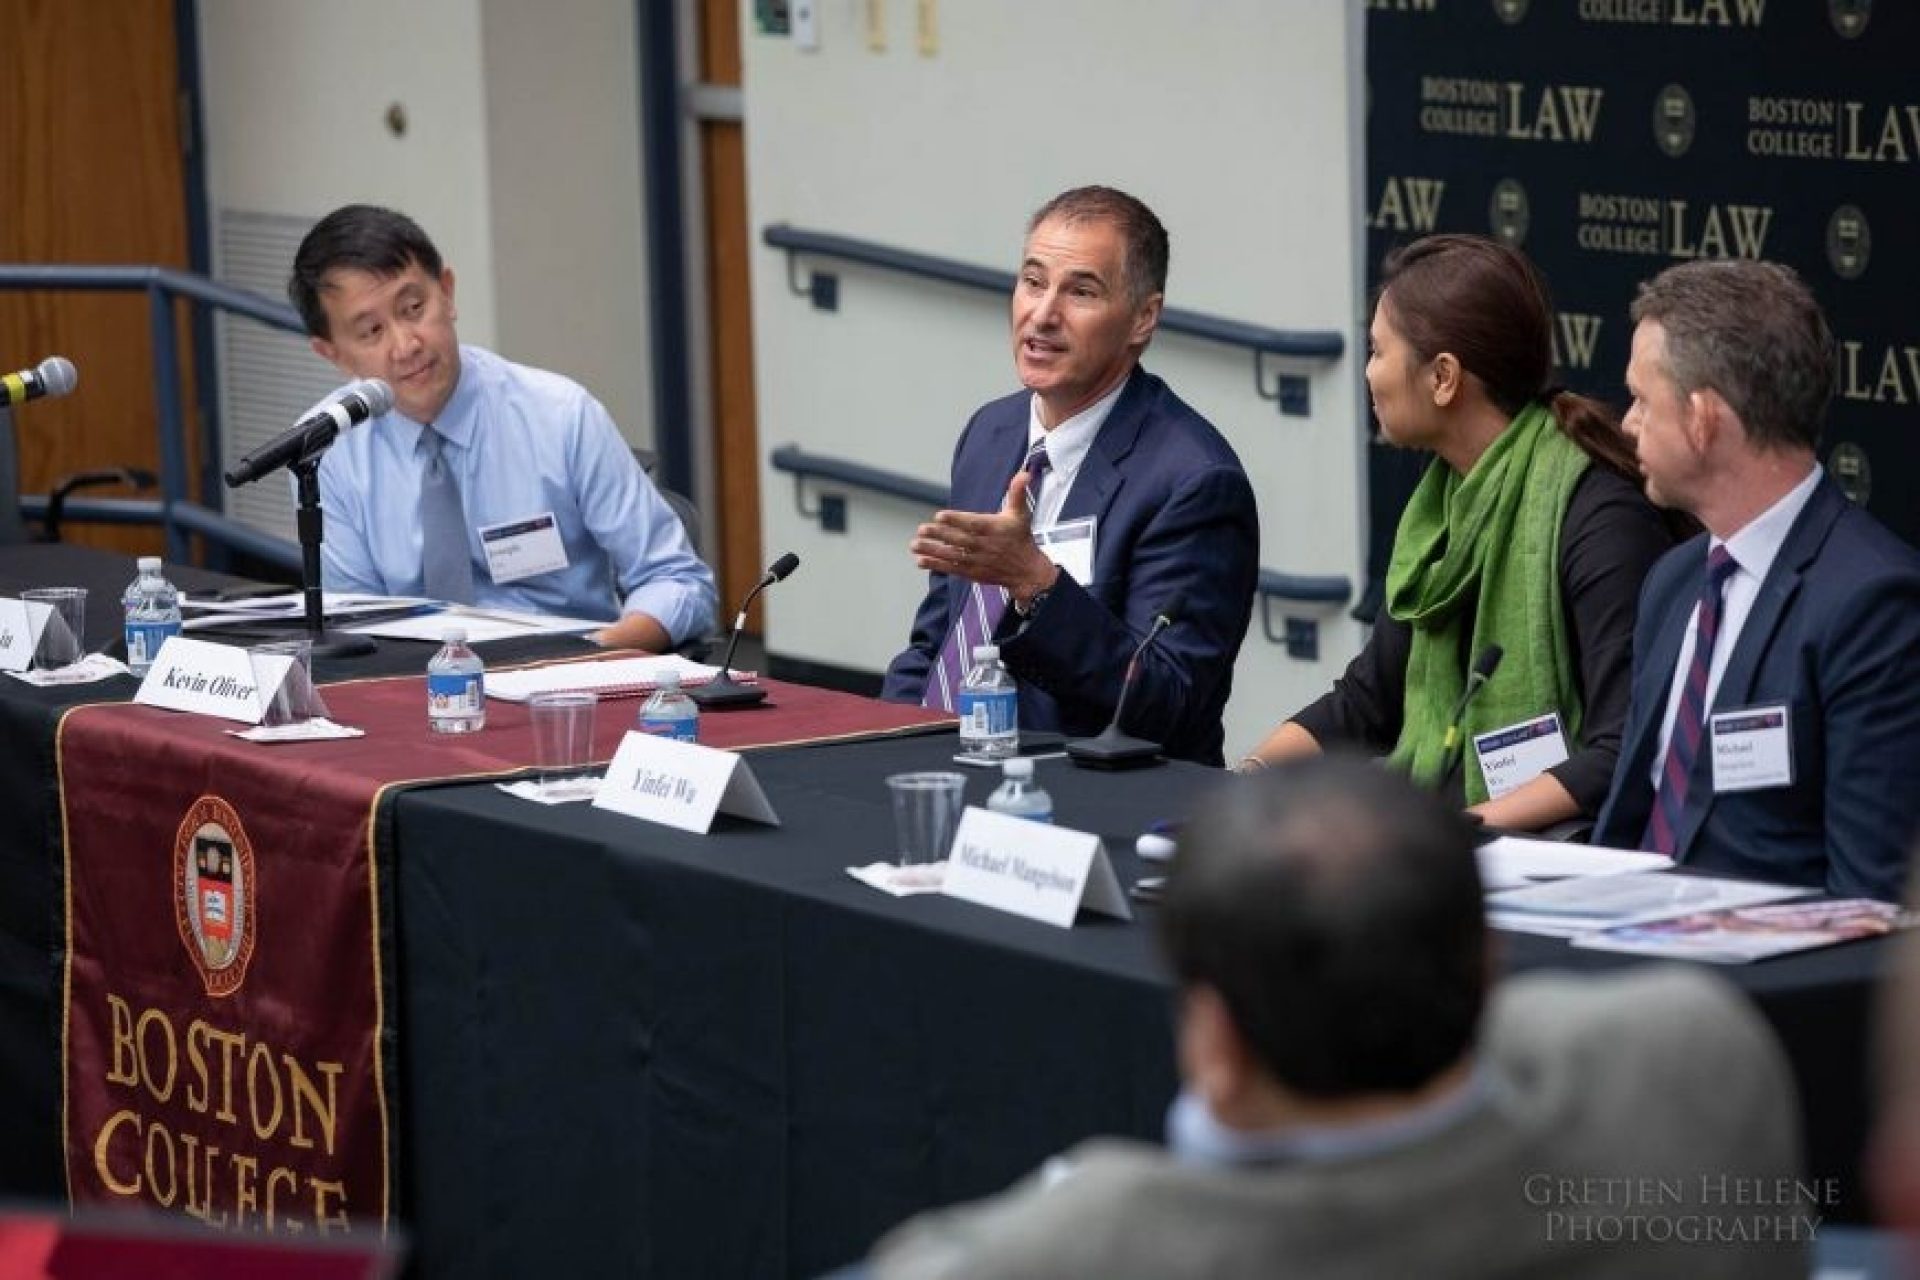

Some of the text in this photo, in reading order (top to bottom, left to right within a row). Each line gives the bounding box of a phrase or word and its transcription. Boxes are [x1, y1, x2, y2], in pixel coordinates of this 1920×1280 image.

[1421, 76, 1498, 105] BOSTON
[1421, 106, 1498, 136] COLLEGE
[1505, 82, 1604, 142] LAW
[1748, 97, 1834, 125] BOSTON
[1747, 130, 1834, 158] COLLEGE
[1579, 193, 1660, 223] BOSTON
[1578, 223, 1660, 254] COLLEGE
[1669, 200, 1772, 261] LAW
[163, 666, 258, 701] Kevin Oliver
[106, 993, 345, 1155] BOSTON
[94, 1110, 351, 1235] COLLEGE
